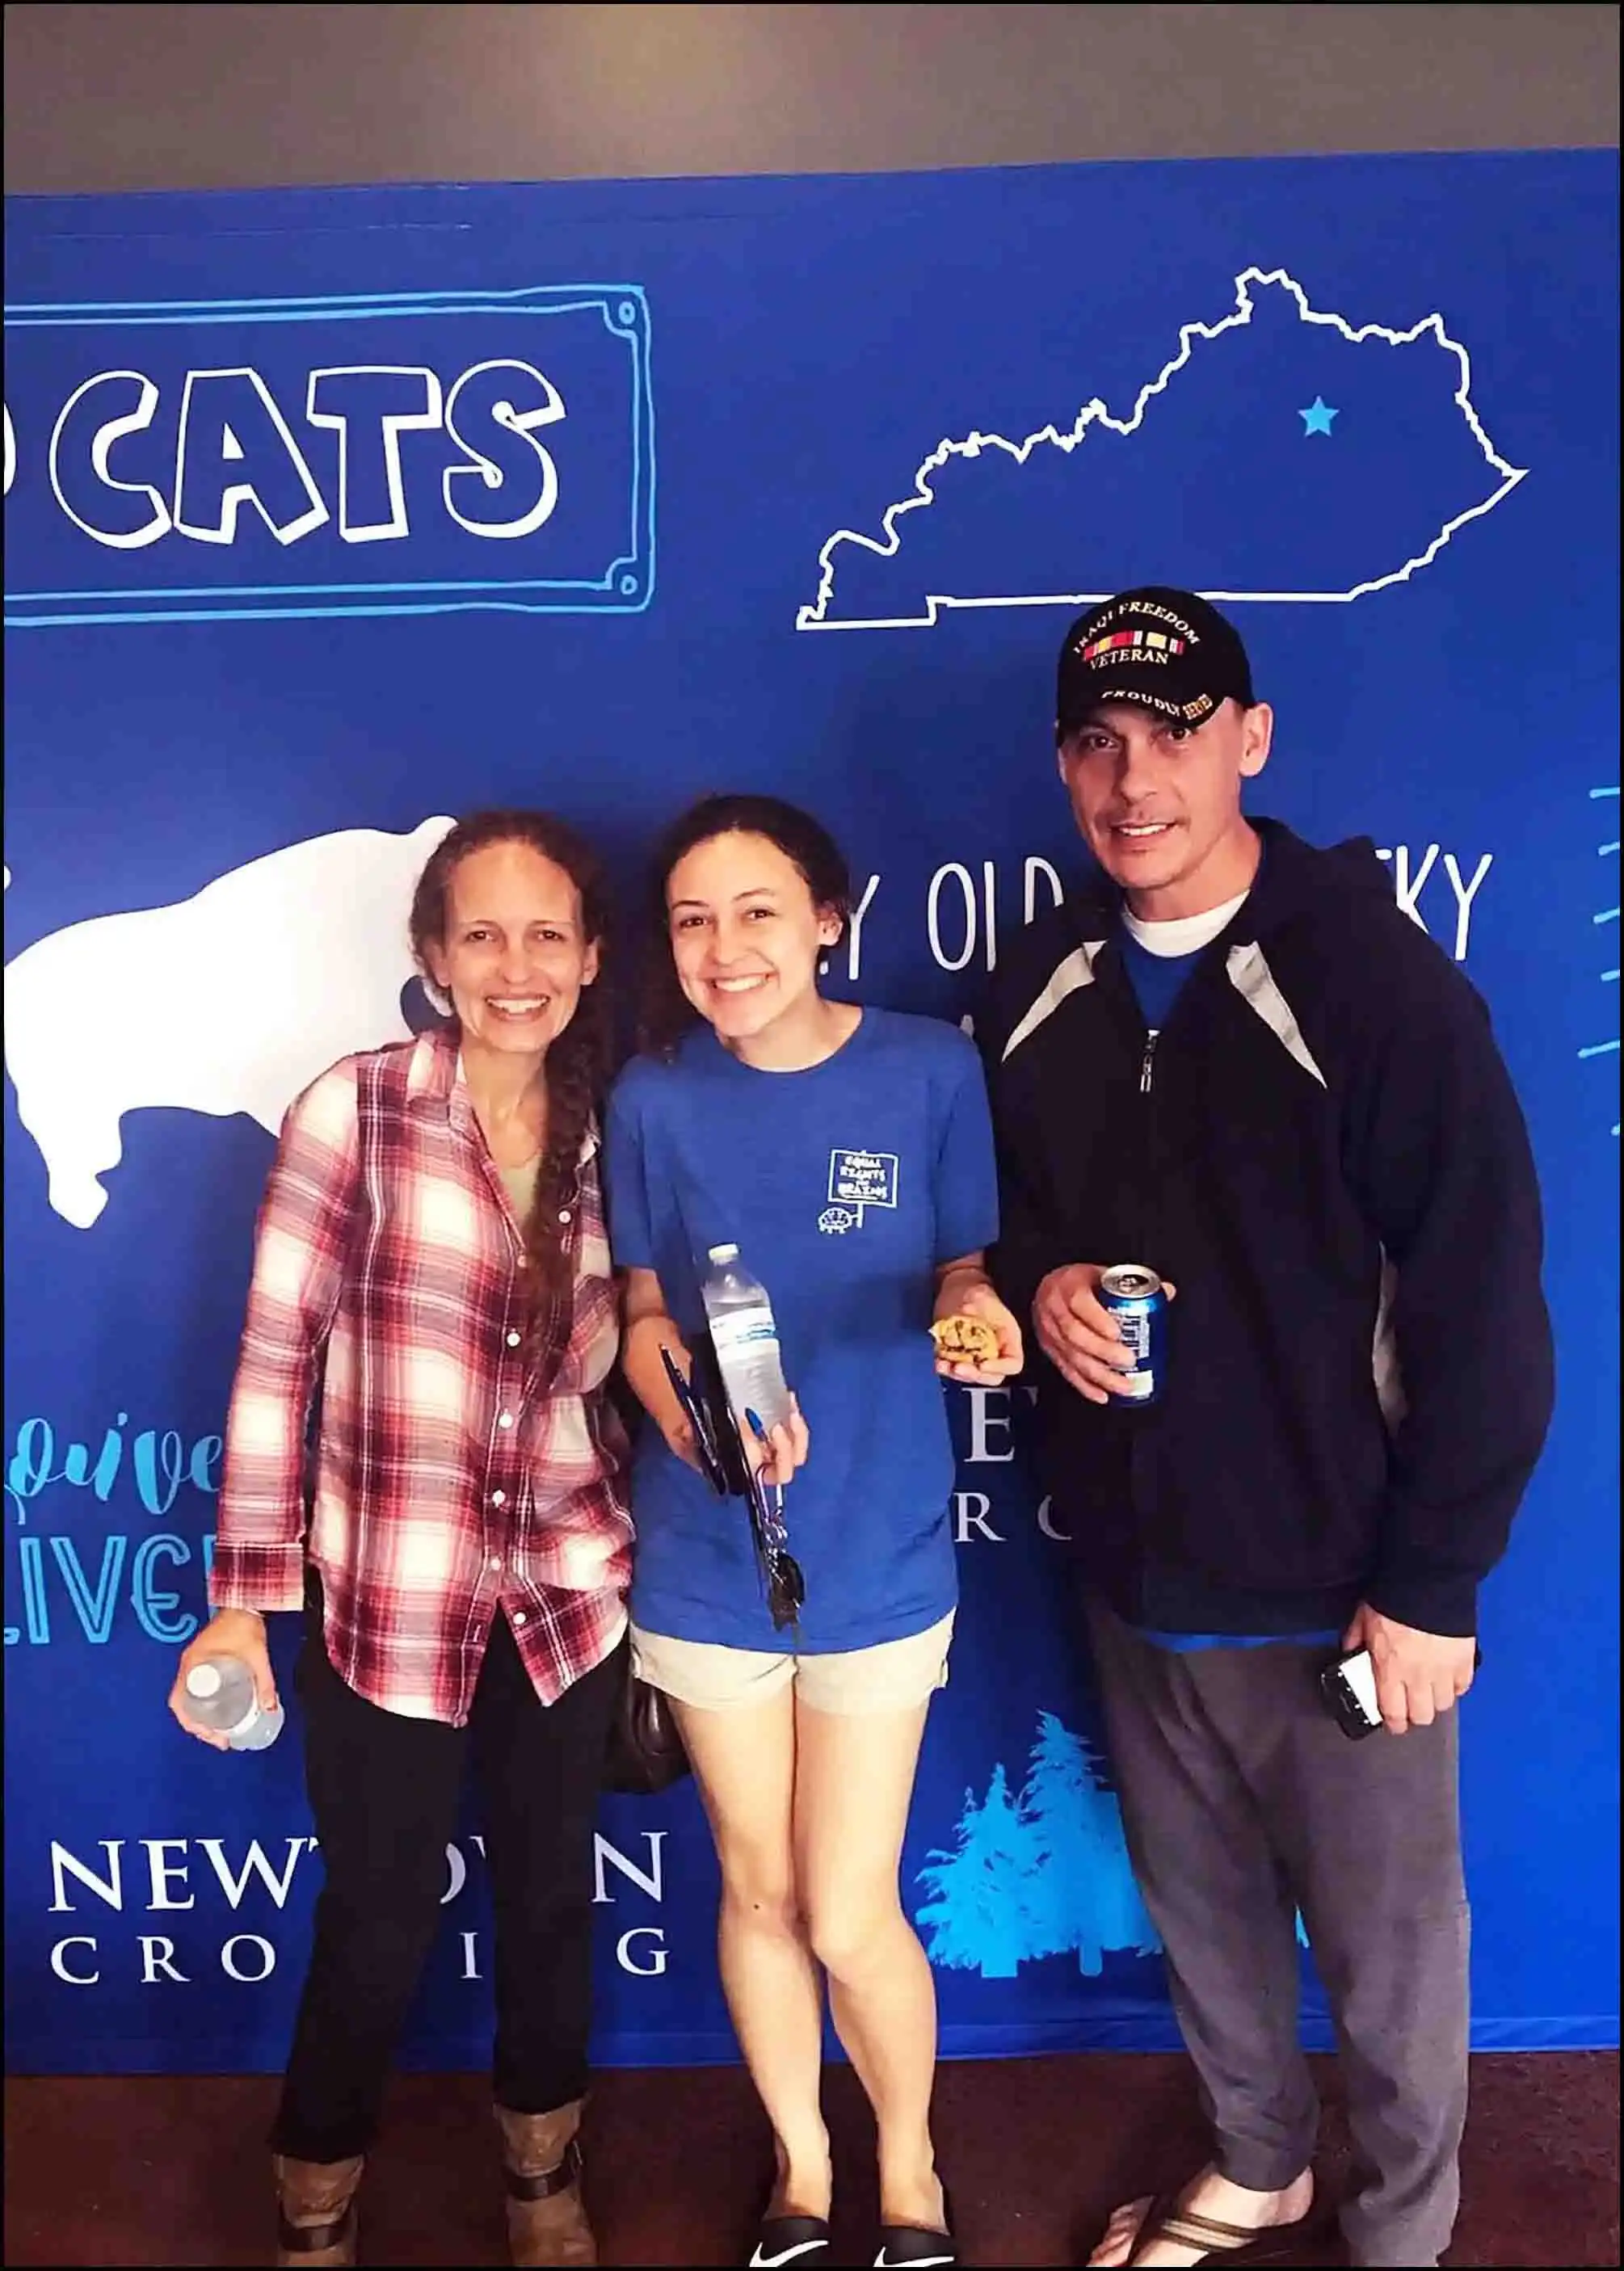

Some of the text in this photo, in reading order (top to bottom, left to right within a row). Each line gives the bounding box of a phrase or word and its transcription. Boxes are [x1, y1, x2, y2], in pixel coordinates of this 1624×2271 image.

[49, 359, 566, 549] CATS
[1119, 601, 1201, 644] FREEDOM
[1090, 649, 1169, 670] VETERAN
[1101, 691, 1180, 717] PROUDLY
[48, 1832, 668, 1911] NEWN
[49, 1928, 669, 1985] CROIG
